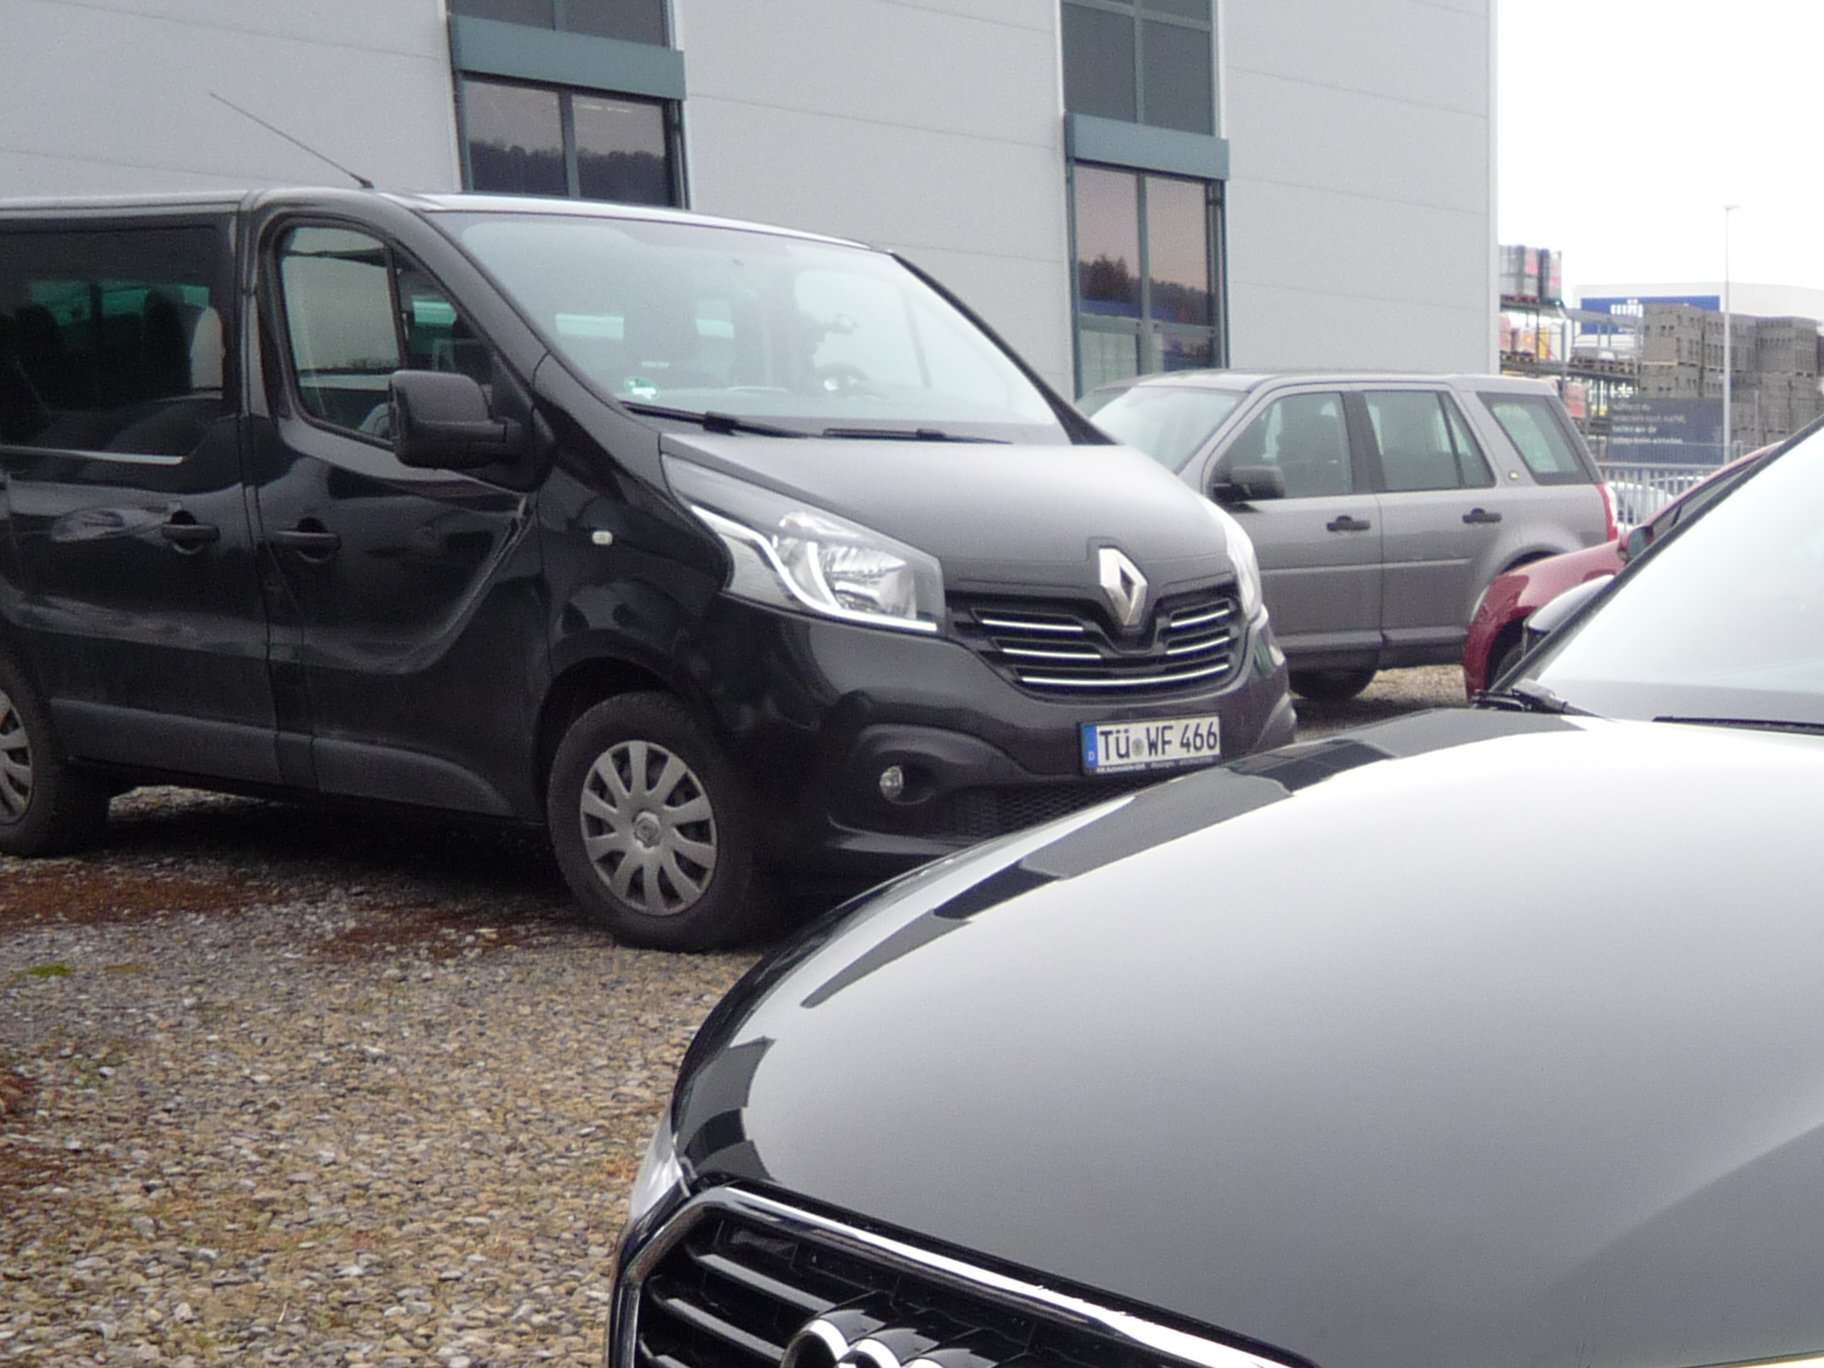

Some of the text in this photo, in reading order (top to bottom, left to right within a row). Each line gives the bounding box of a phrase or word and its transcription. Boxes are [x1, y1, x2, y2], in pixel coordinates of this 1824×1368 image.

[1099, 721, 1218, 761] TÜ WF 466
